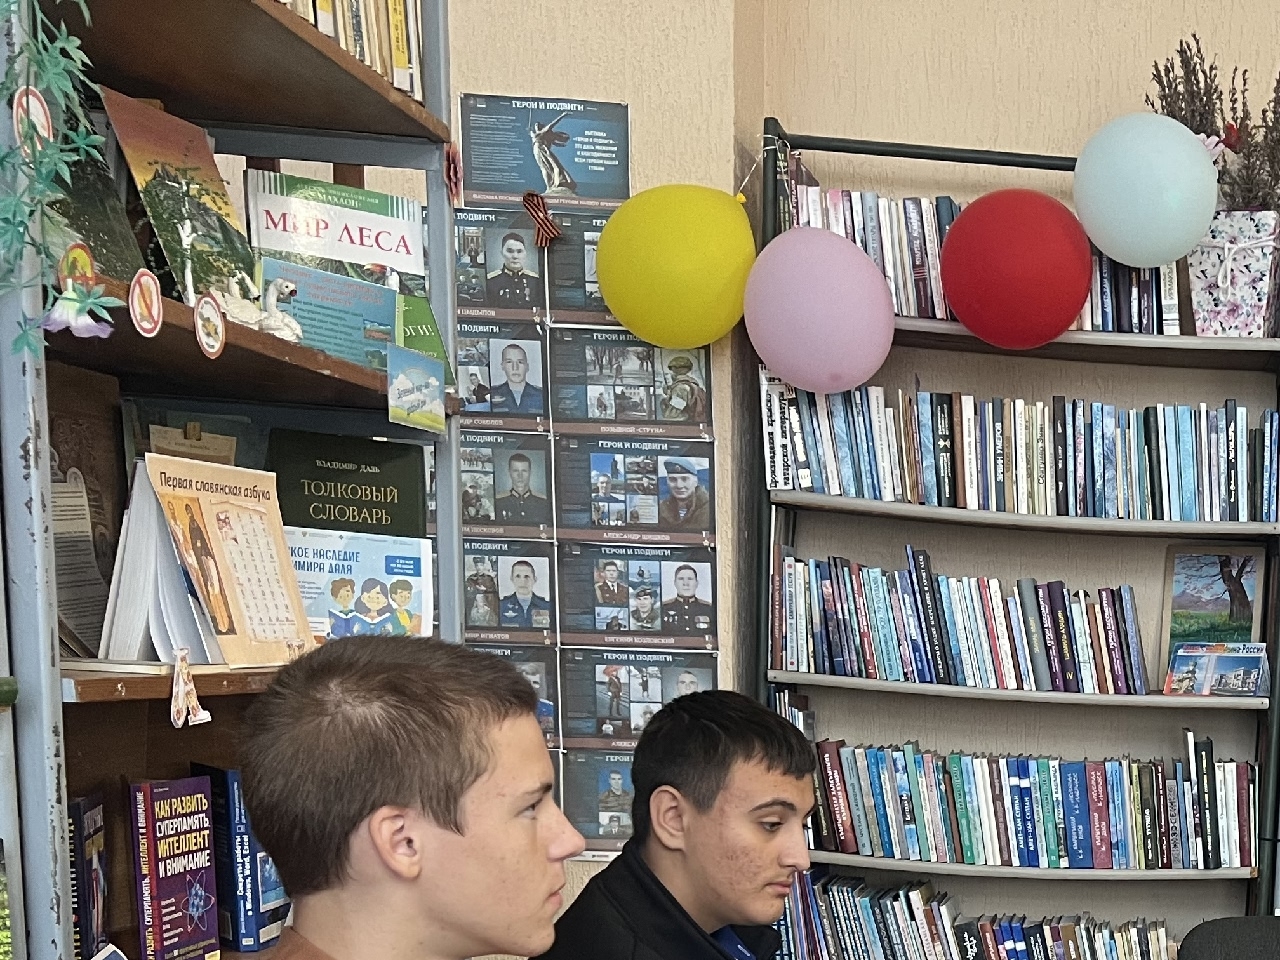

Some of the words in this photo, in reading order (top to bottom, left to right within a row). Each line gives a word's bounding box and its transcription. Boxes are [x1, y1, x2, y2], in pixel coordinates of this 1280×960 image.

[457, 212, 495, 221] ПОДВИГИ
[338, 222, 413, 256] ЛЕСА
[463, 324, 499, 333] ПОДВИГИ
[593, 333, 618, 341] ГЕРОИ
[466, 434, 504, 443] ПОДВИГИ
[631, 442, 668, 450] ПОДВИГИ
[316, 459, 358, 470] ВЛАДИМИР
[360, 465, 380, 473] ДАЛЬ
[160, 472, 193, 491] Первая
[195, 480, 241, 496] славянская
[243, 485, 271, 502] азбука
[300, 479, 398, 504] ТОЛКОВЫЙ
[309, 502, 391, 525] СЛОВАРЬ
[472, 543, 508, 551] ПОДВИГИ
[634, 548, 671, 556] ПОДВИГИ
[289, 547, 310, 558] КОЕ
[312, 548, 360, 563] НАСЛЕДИЕ
[328, 564, 353, 575] ДАЛЯ
[636, 654, 673, 662] ПОДВИГИ
[154, 800, 171, 819] КАК
[172, 793, 209, 815] РАЗВИТЬ
[157, 829, 210, 859] ИНТЕЛЛЕКТ
[235, 835, 243, 862] работы
[159, 861, 165, 878] И
[166, 850, 211, 877] ВНИМАНИЕ
